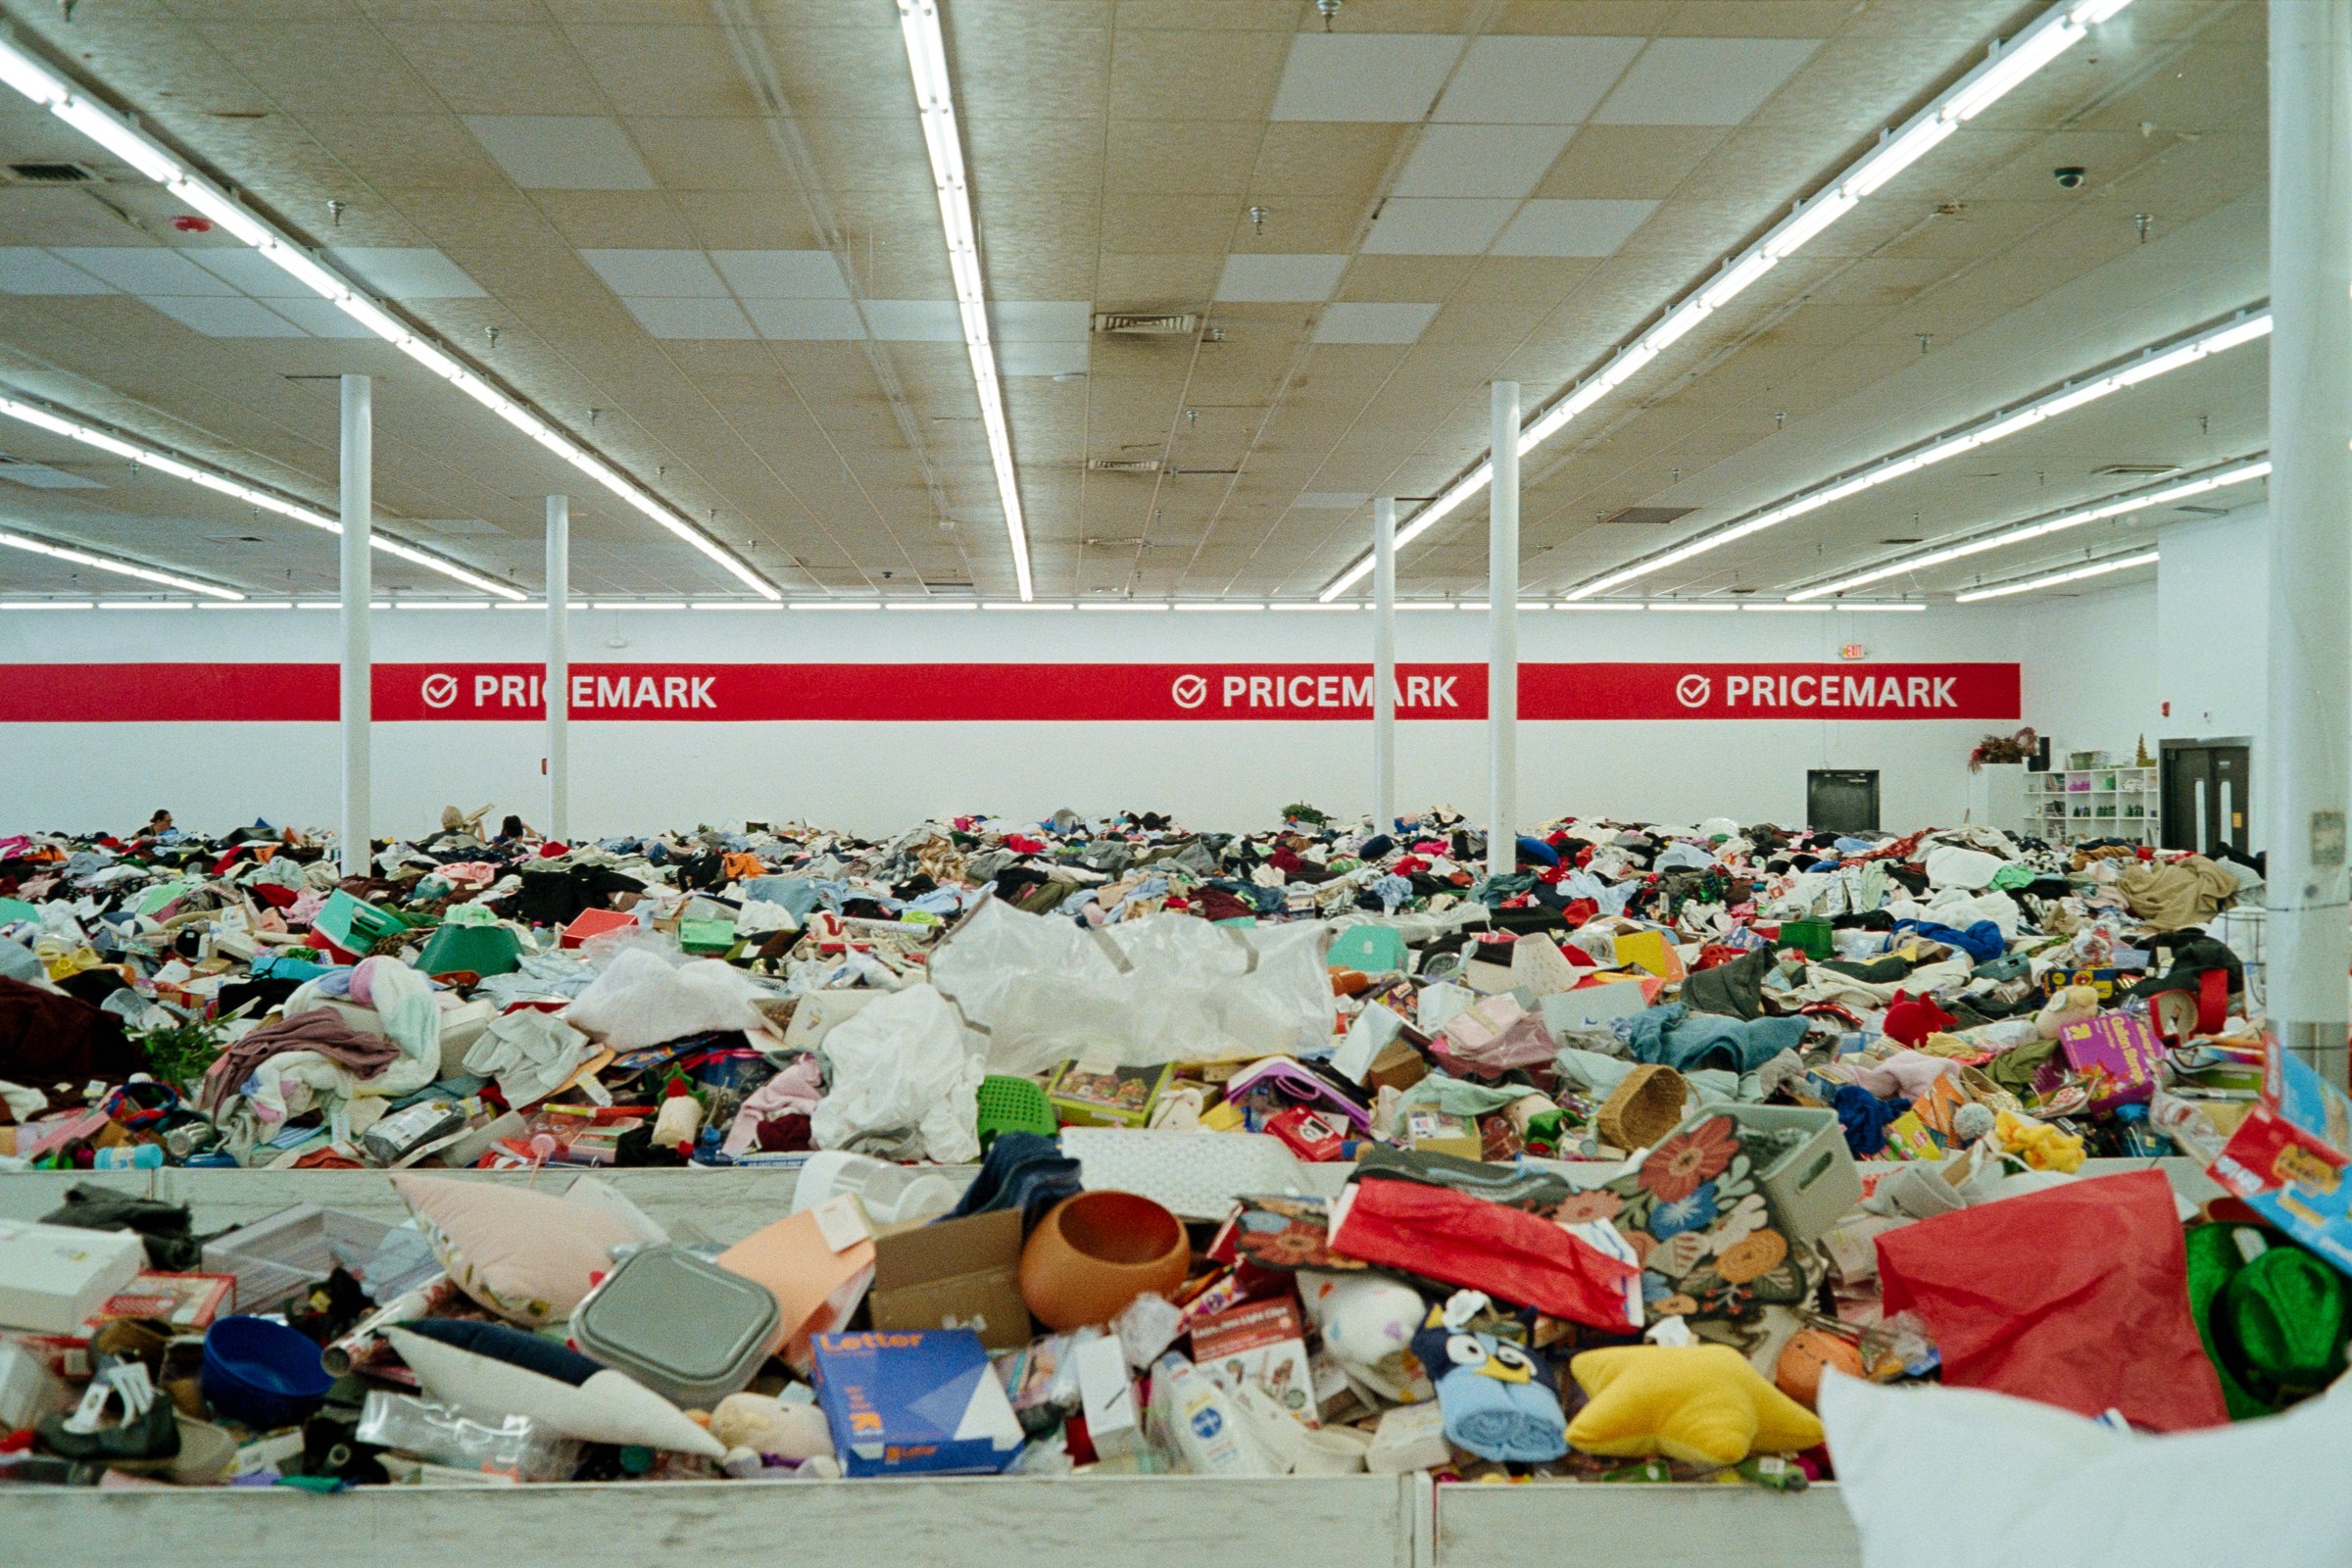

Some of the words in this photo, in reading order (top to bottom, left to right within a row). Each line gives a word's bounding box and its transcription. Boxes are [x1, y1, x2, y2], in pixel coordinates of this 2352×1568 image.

[1846, 645, 1862, 657] EXIT
[474, 676, 716, 708] PRIEMARK
[1727, 676, 1957, 707] PRICEMARK
[819, 1333, 924, 1350] Letter
